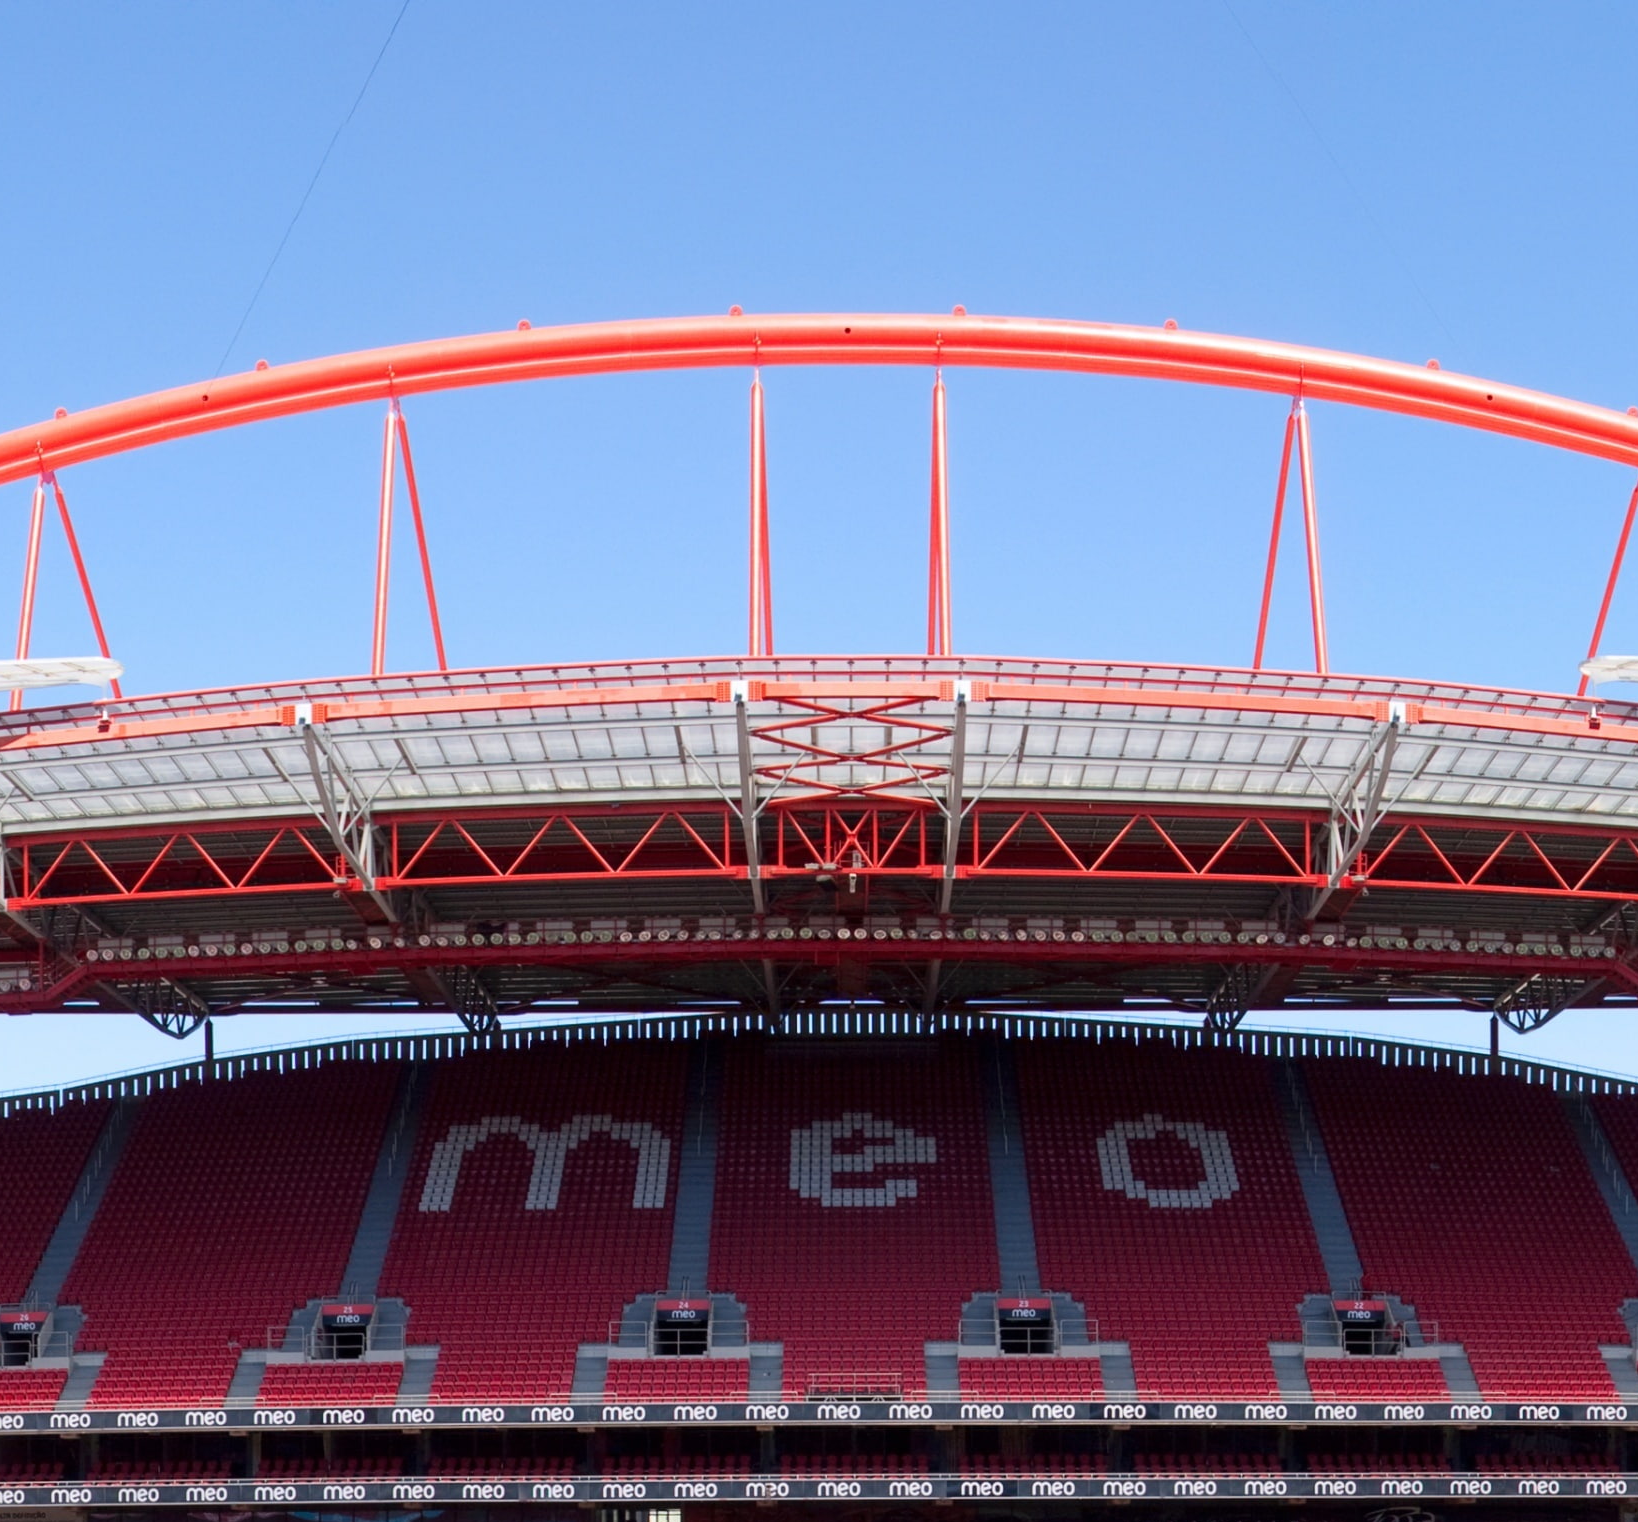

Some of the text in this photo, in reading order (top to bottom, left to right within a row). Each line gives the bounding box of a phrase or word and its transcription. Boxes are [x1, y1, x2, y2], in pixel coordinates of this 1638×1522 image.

[419, 1112, 1240, 1212] meo
[671, 1309, 696, 1319] meo
[1347, 1309, 1371, 1320] meo
[392, 1409, 434, 1422] meo
[1587, 1406, 1627, 1420] meo
[119, 1488, 159, 1502] meo
[961, 1482, 1003, 1495] meo
